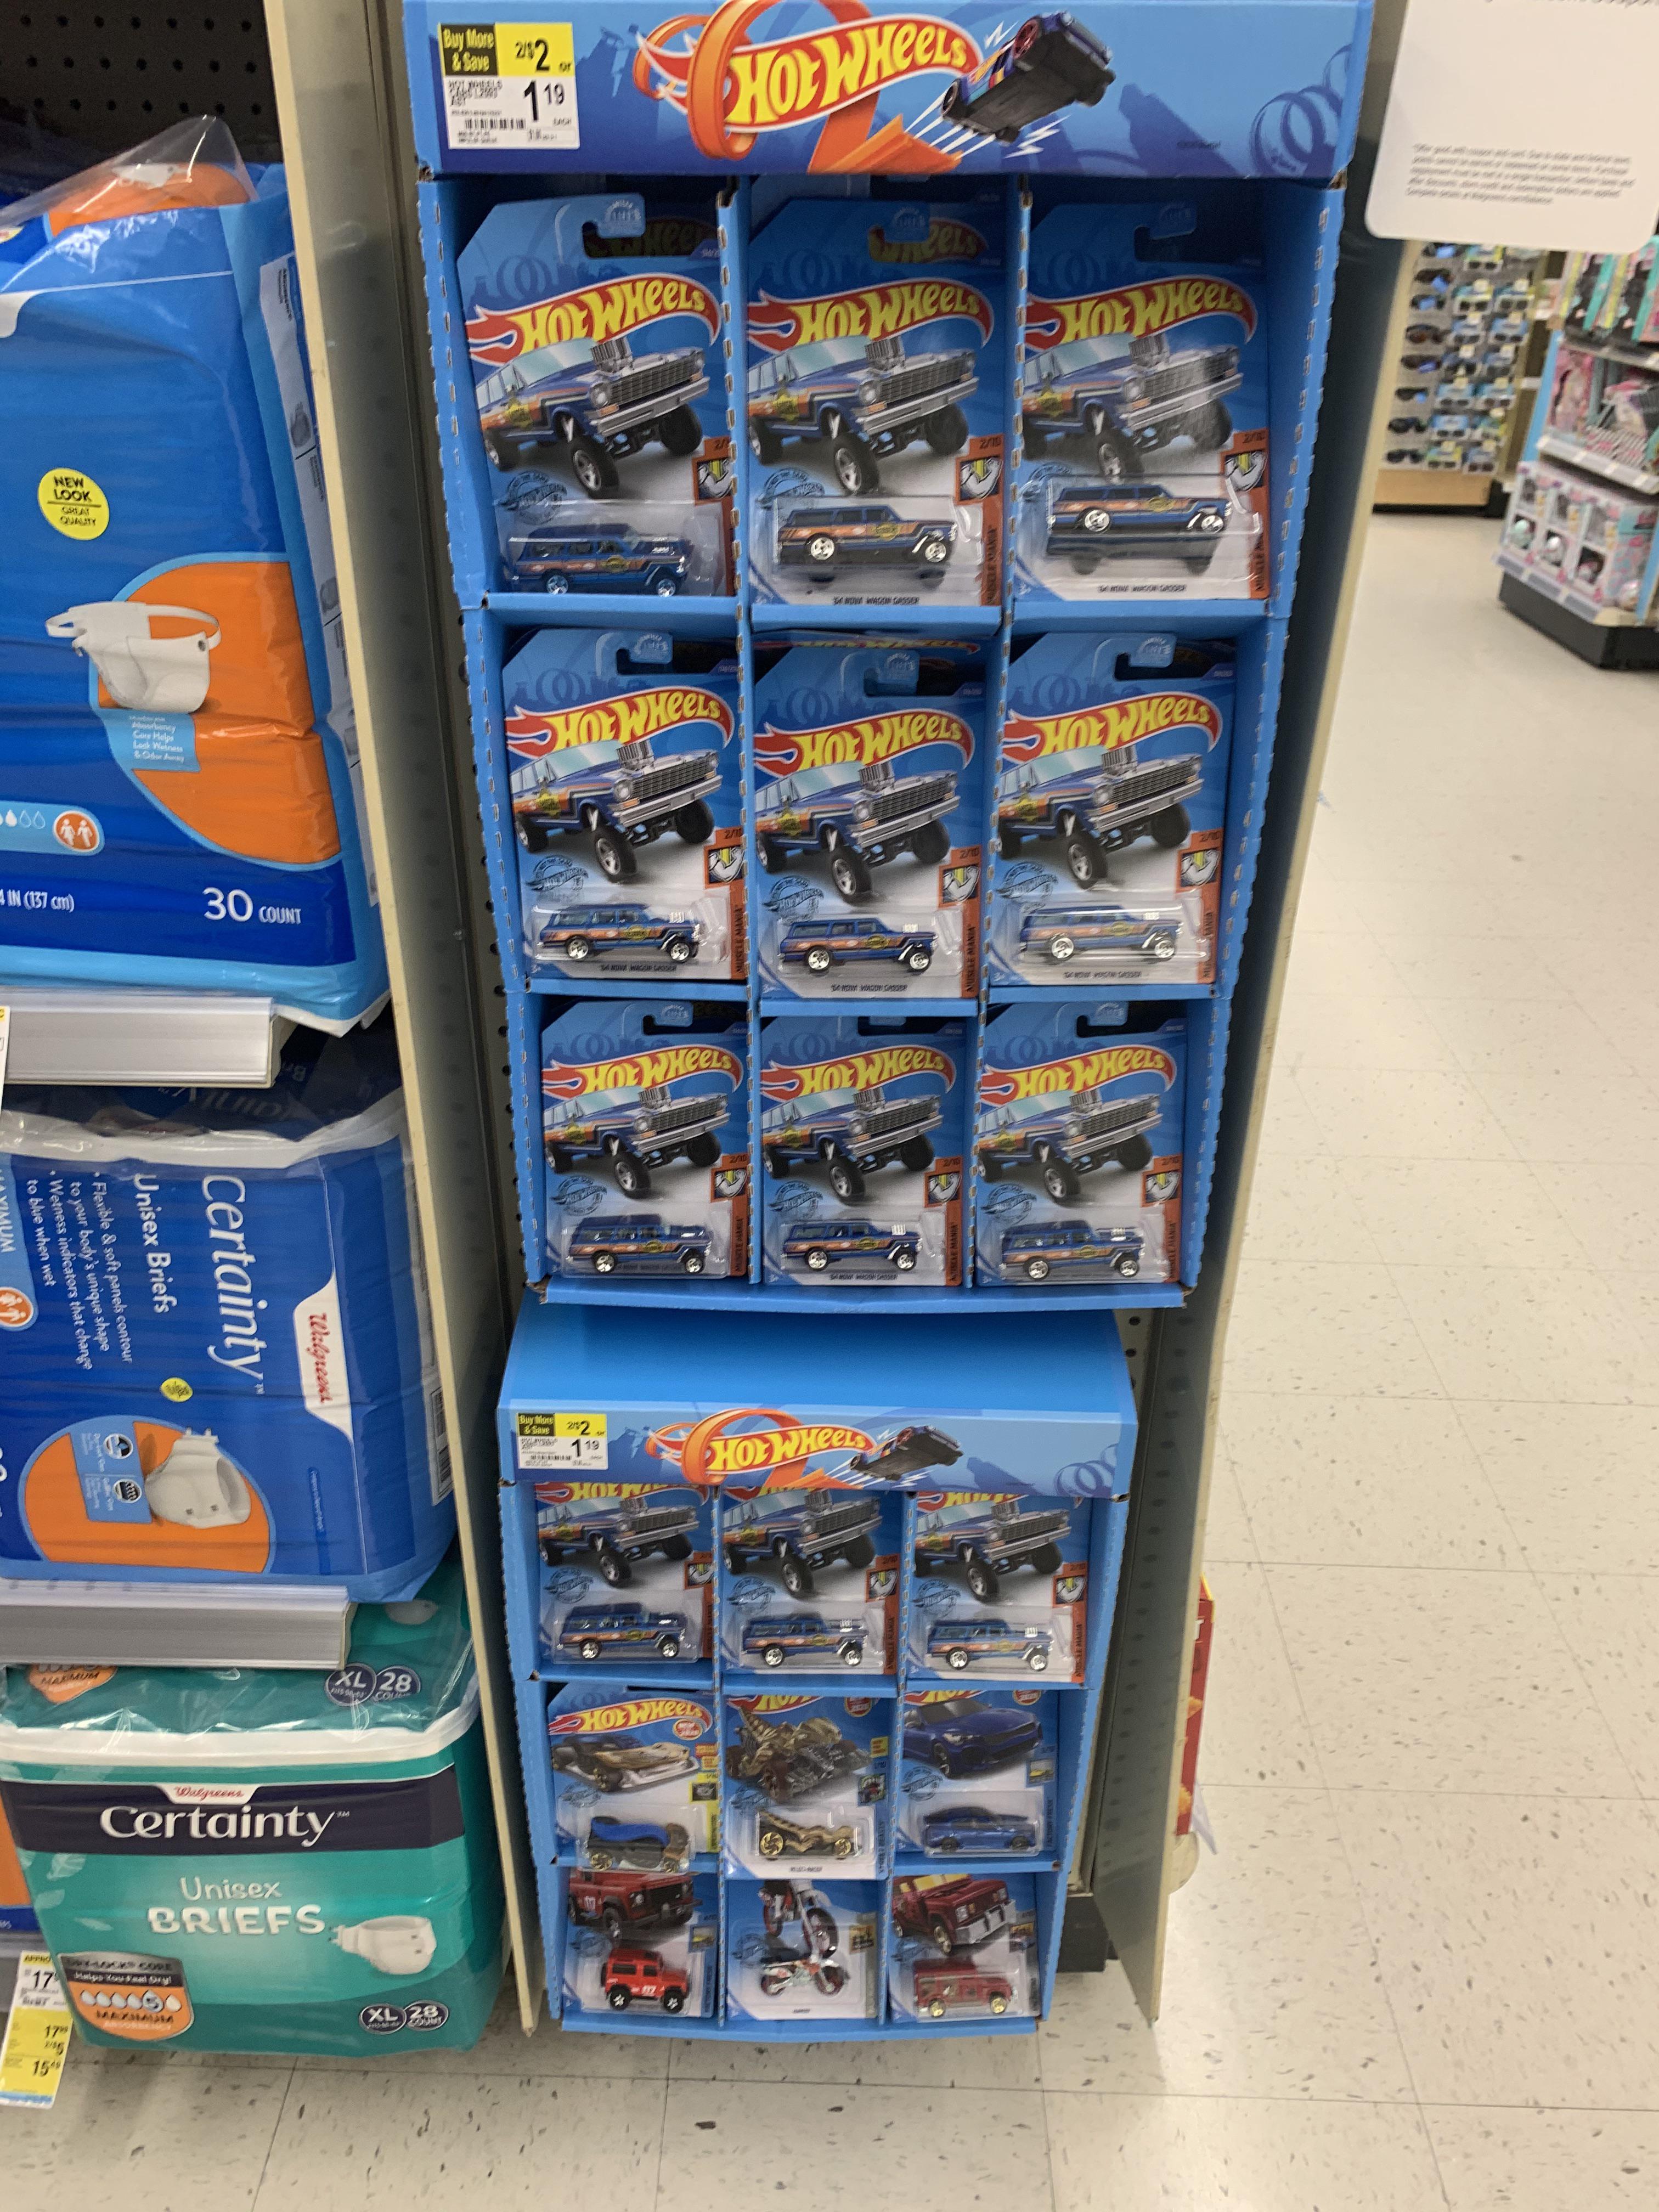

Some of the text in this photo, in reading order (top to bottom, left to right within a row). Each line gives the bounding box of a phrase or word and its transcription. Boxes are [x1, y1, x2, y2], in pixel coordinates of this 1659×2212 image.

[443, 28, 494, 52] Buy More
[452, 51, 490, 72] & Save
[54, 475, 84, 488] NEW
[53, 489, 93, 503] LOOK
[59, 516, 97, 527] QUALITY
[61, 506, 90, 516] GREAT
[24, 890, 48, 910] (137
[50, 894, 75, 913] cm)
[202, 887, 302, 925] 30 COUNT
[70, 1181, 82, 1197] to
[66, 1199, 88, 1227] your
[26, 1180, 57, 1287] to blue when wet
[133, 1172, 178, 1313] Unisex Briefs
[49, 1178, 93, 1370] Wetness indicators that change
[92, 1181, 133, 1363] Flexible & soft panels contour
[84, 1273, 104, 1315] unique
[93, 1316, 110, 1352] shape
[306, 1312, 333, 1404] Walgreens
[520, 1414, 554, 1425] Buy More
[532, 1425, 550, 1435] Save
[334, 1671, 367, 1689] XL
[379, 1671, 412, 1692] 28
[173, 1785, 245, 1801] Walgreens
[99, 1804, 336, 1848] Certainty
[179, 1875, 283, 1901] Unisex
[147, 1904, 326, 1936] BRIEFS
[367, 2007, 399, 2023] XL
[408, 2004, 439, 2019] 28
